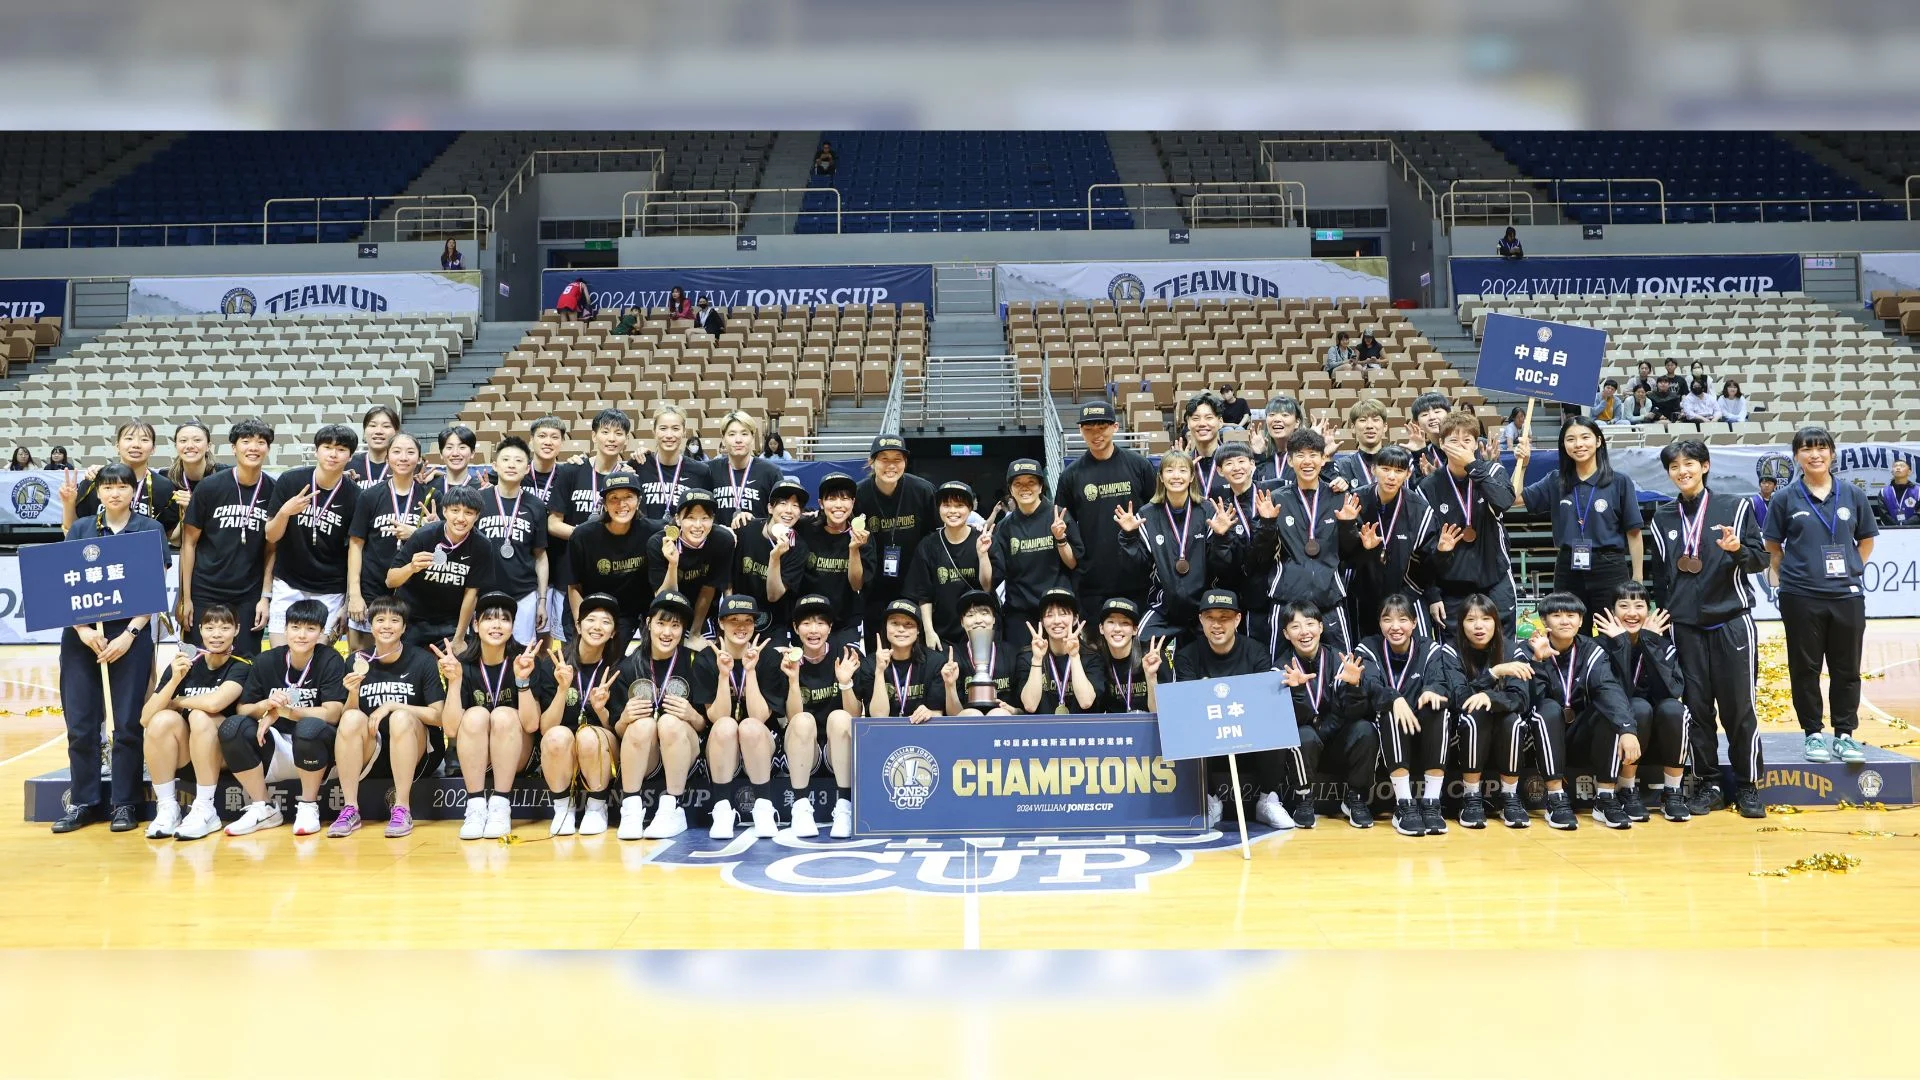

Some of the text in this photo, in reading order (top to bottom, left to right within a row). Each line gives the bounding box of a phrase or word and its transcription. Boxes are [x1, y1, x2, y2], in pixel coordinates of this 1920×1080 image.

[1153, 270, 1237, 299] TEAM
[1240, 272, 1279, 299] UP
[1481, 278, 1528, 296] 2024
[1636, 277, 1715, 295] JONES
[1717, 276, 1774, 294] CUP
[264, 284, 348, 315] TEAM
[349, 287, 388, 314] UP
[590, 291, 636, 309] 2024
[746, 288, 828, 308] JONES
[831, 288, 888, 307] CUP
[1514, 344, 1568, 367] 中華白
[1514, 367, 1559, 387] ROC-B
[17, 503, 43, 512] JONES
[20, 510, 39, 518] CUP
[484, 526, 524, 543] TAIEI
[64, 563, 126, 587] 中華藍
[424, 570, 465, 587] TAIPEI
[1861, 560, 1920, 593] 024
[70, 589, 122, 611] ROC-A
[360, 682, 416, 698] CHINESE
[1206, 701, 1245, 720] 日本
[1216, 724, 1243, 740] JPN
[952, 756, 1177, 796] CHAMPIONS
[1754, 770, 1833, 798] EAM UP
[432, 788, 467, 808] 202
[892, 786, 929, 800] JONES
[1448, 780, 1500, 800] CP
[898, 796, 924, 808] CUP
[1016, 803, 1114, 812] 2024 WILLIAM JONES CUP
[764, 846, 1152, 886] CUP
